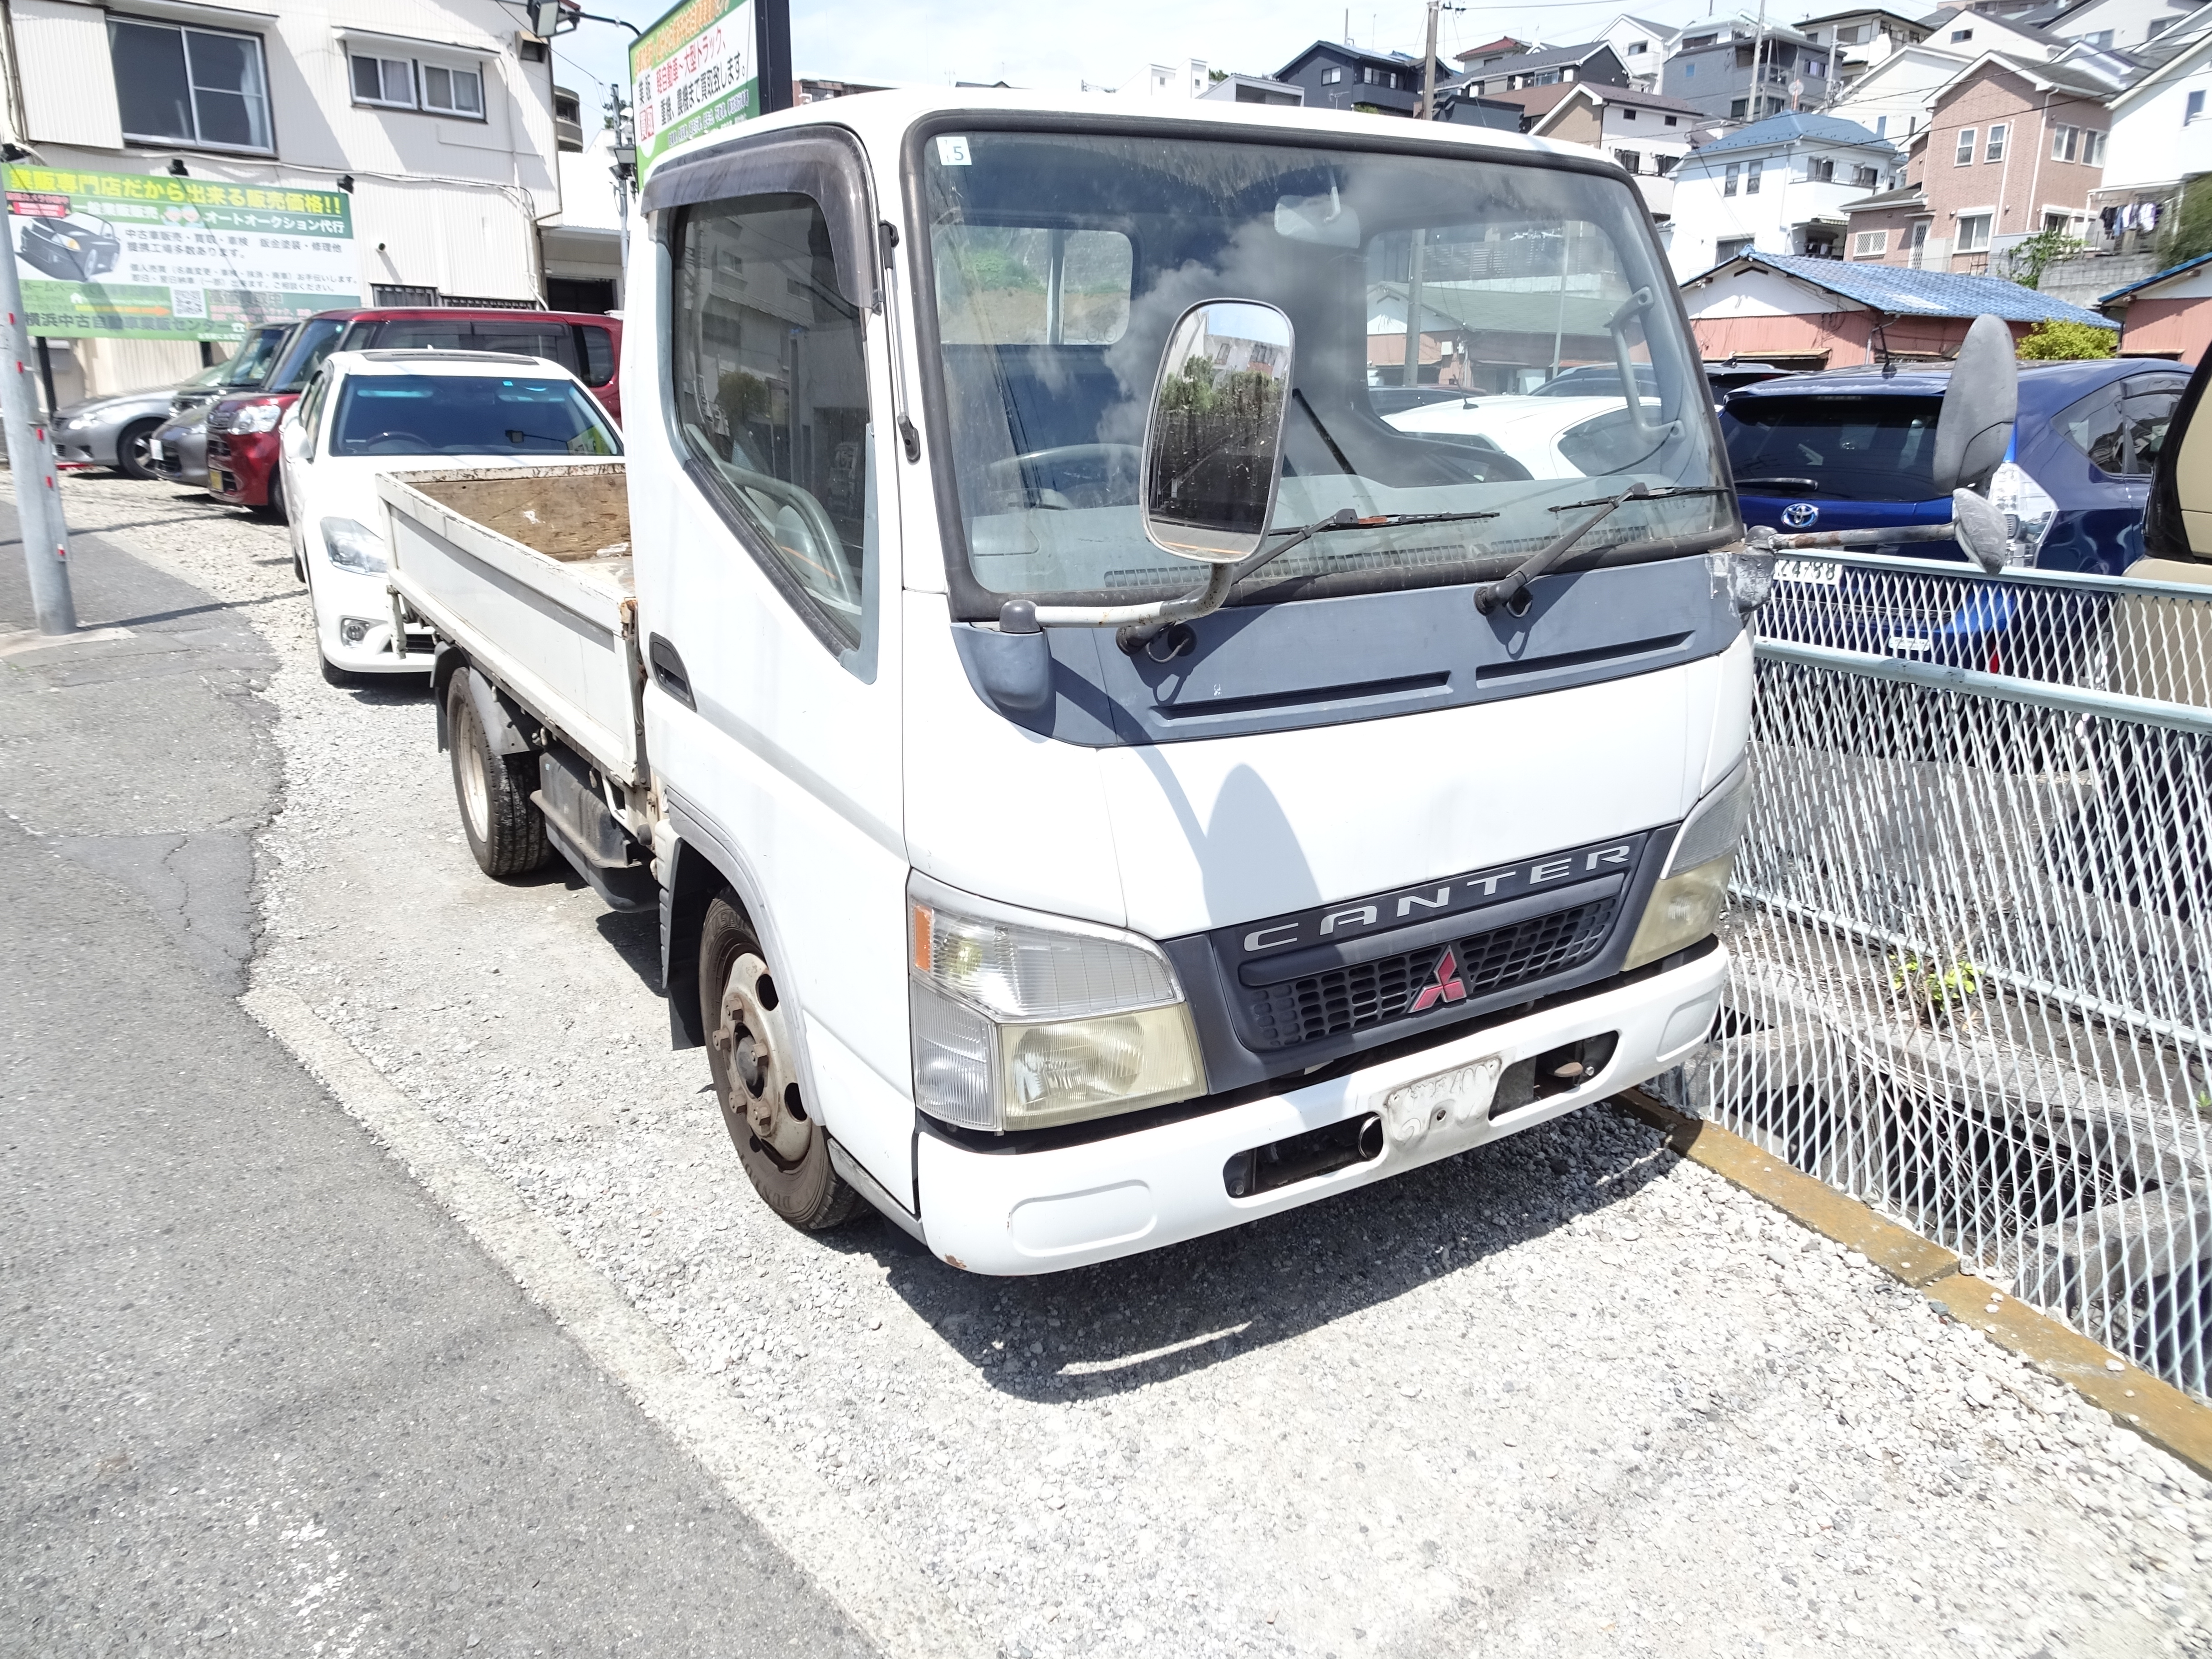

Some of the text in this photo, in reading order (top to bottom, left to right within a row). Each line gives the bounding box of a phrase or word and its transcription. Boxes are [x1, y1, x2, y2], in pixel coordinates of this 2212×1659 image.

[953, 145, 964, 161] 5
[204, 209, 344, 234] オートオークション代行
[1243, 845, 1630, 952] CANTER
